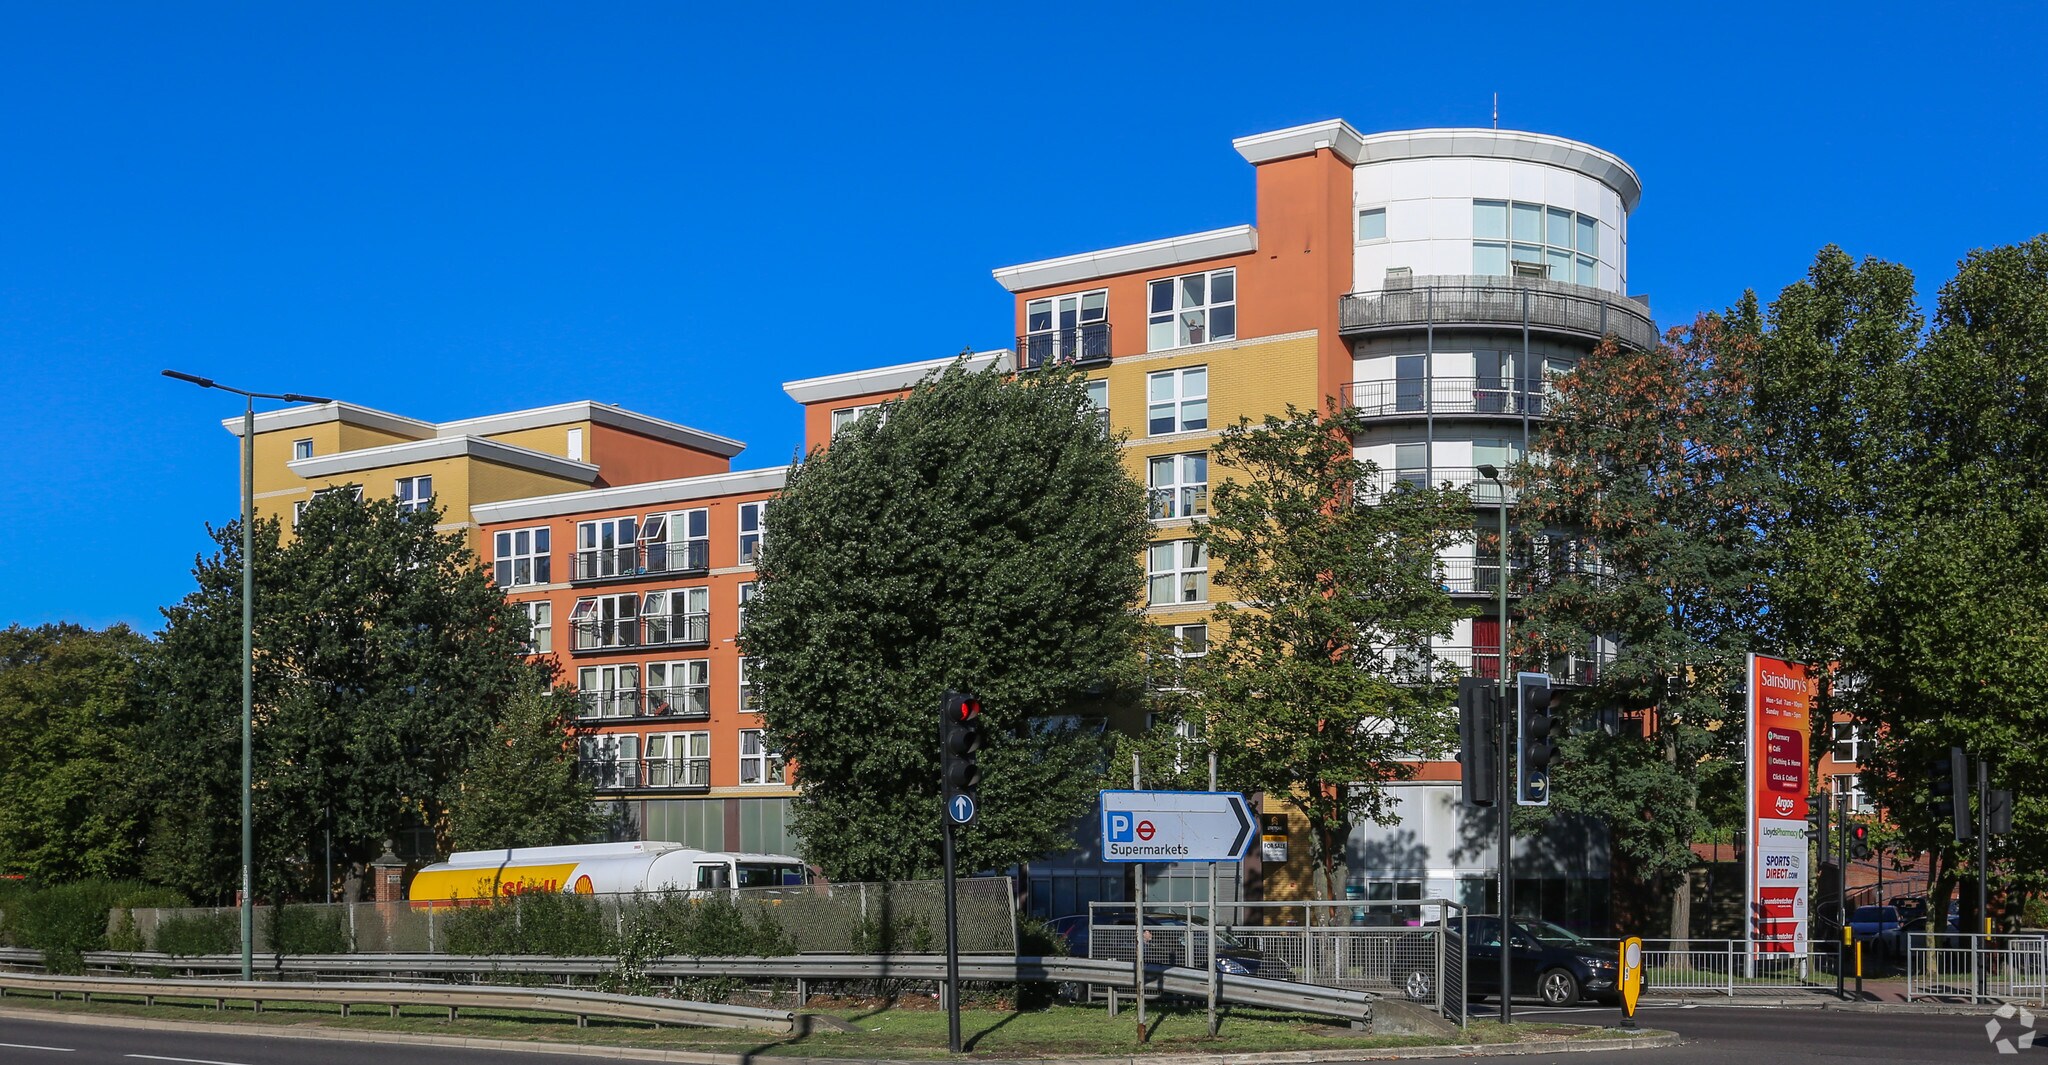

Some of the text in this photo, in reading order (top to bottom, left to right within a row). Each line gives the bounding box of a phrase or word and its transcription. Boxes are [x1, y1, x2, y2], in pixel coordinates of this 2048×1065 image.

[1761, 670, 1807, 695] Sainsbury's
[1766, 708, 1779, 716] Sunday
[1773, 733, 1790, 742] Pharmacy
[1773, 758, 1787, 766] Clothing
[1775, 796, 1794, 811] Argos
[1763, 827, 1798, 839] LloydsPharmacy
[1110, 843, 1189, 856] Supermarkets
[1766, 856, 1790, 866] SPORTS
